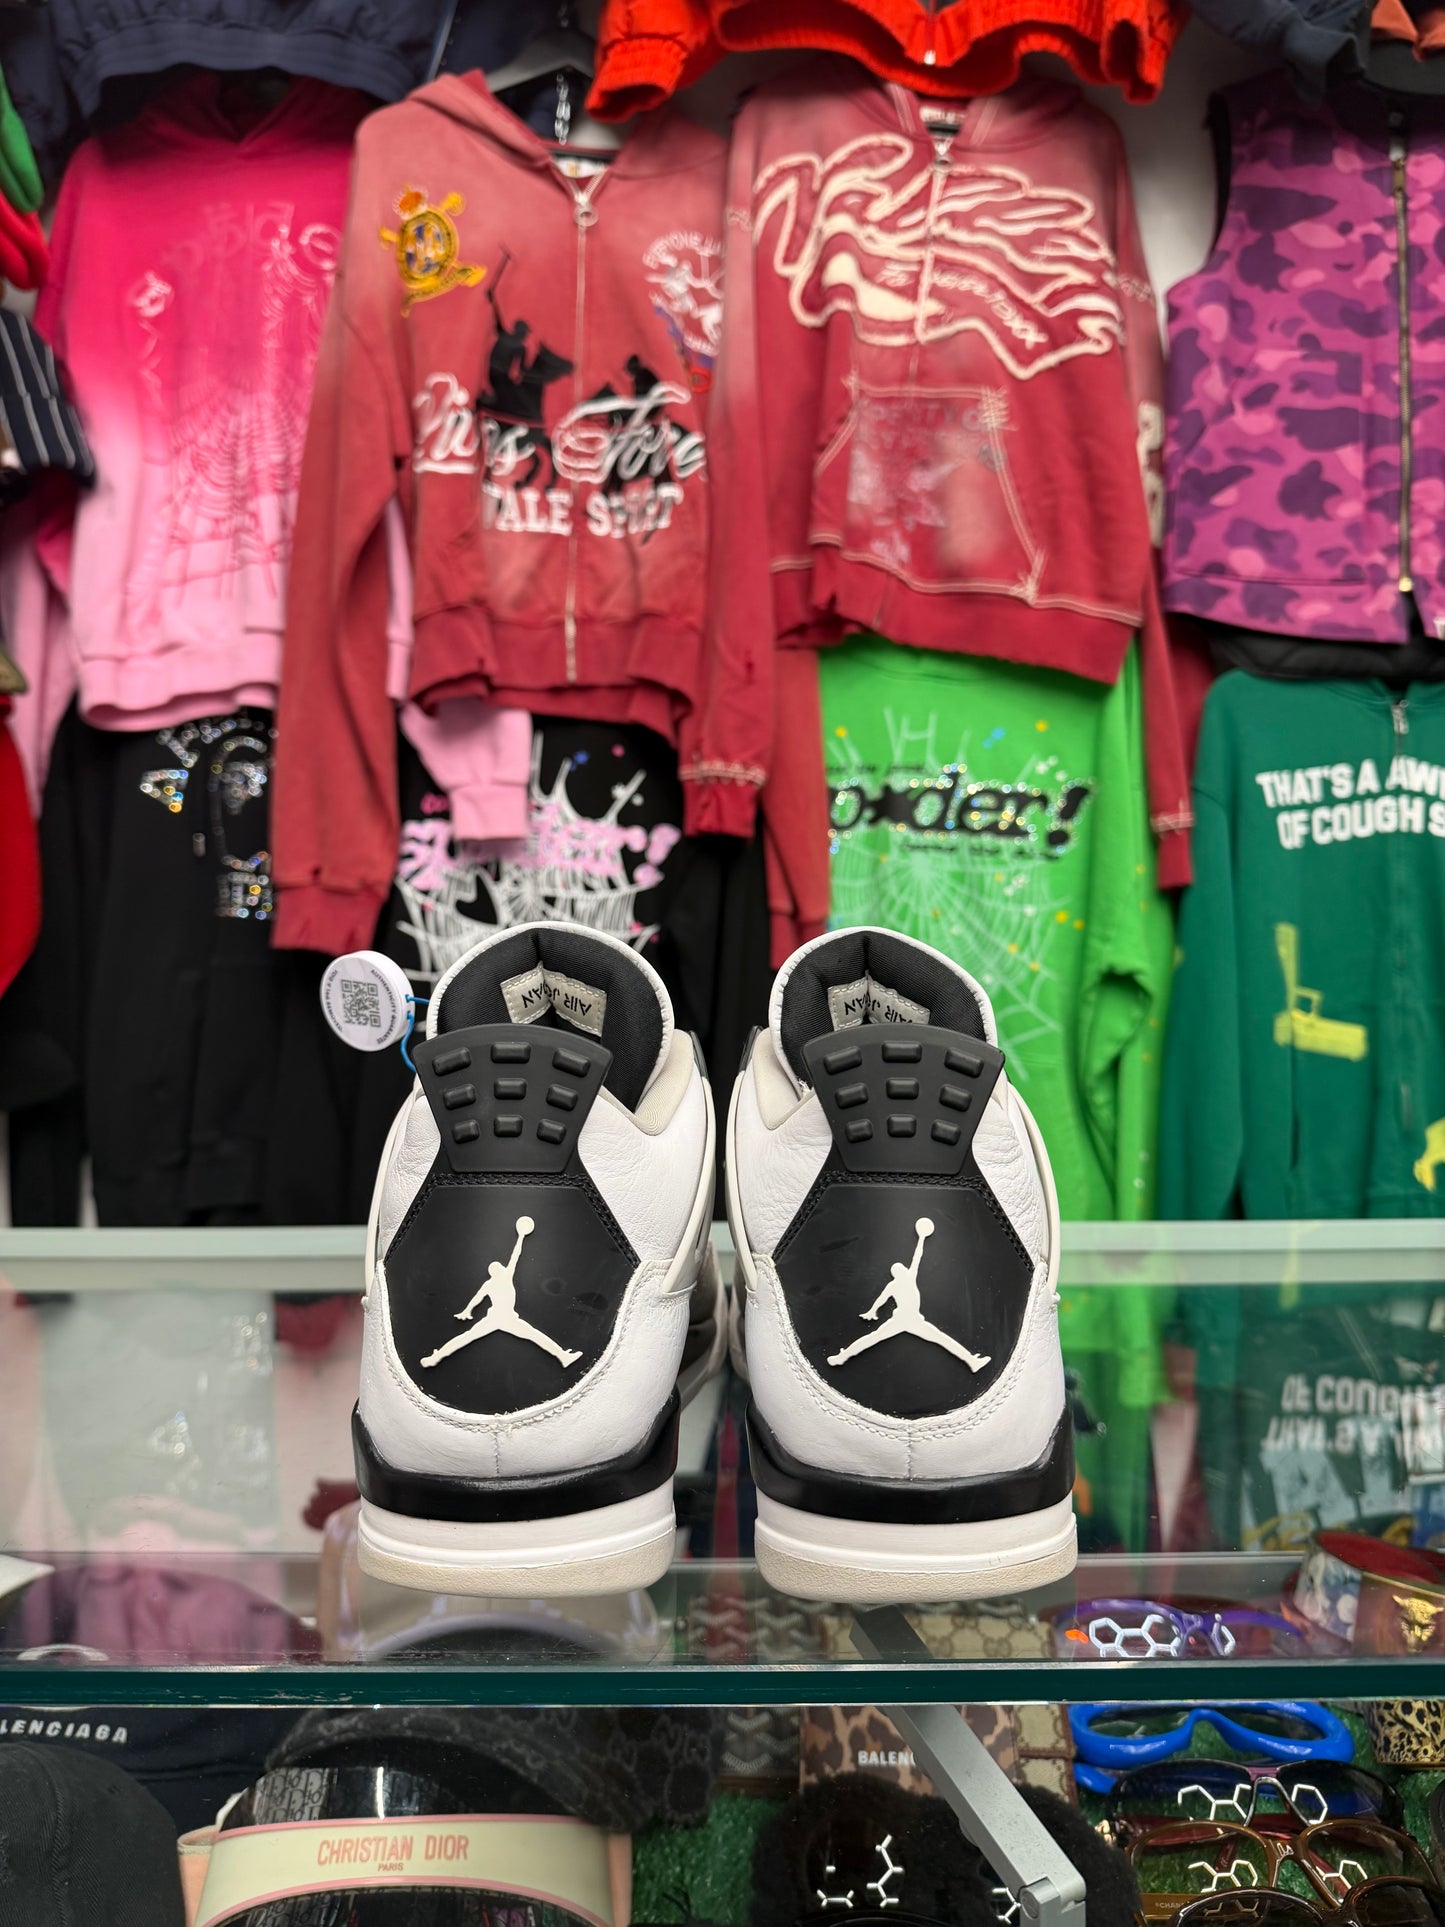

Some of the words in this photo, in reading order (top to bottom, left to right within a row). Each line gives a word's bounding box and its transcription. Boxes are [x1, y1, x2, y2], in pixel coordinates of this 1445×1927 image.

[1255, 762, 1354, 808] THAT'S
[1356, 758, 1381, 795] A
[1276, 809, 1309, 850] OF
[1311, 794, 1426, 845] COUGH
[563, 993, 592, 1016] AIR
[317, 1835, 414, 1866] CHRISTIAN
[424, 1834, 469, 1861] DIOR
[377, 1862, 404, 1872] PARIS
